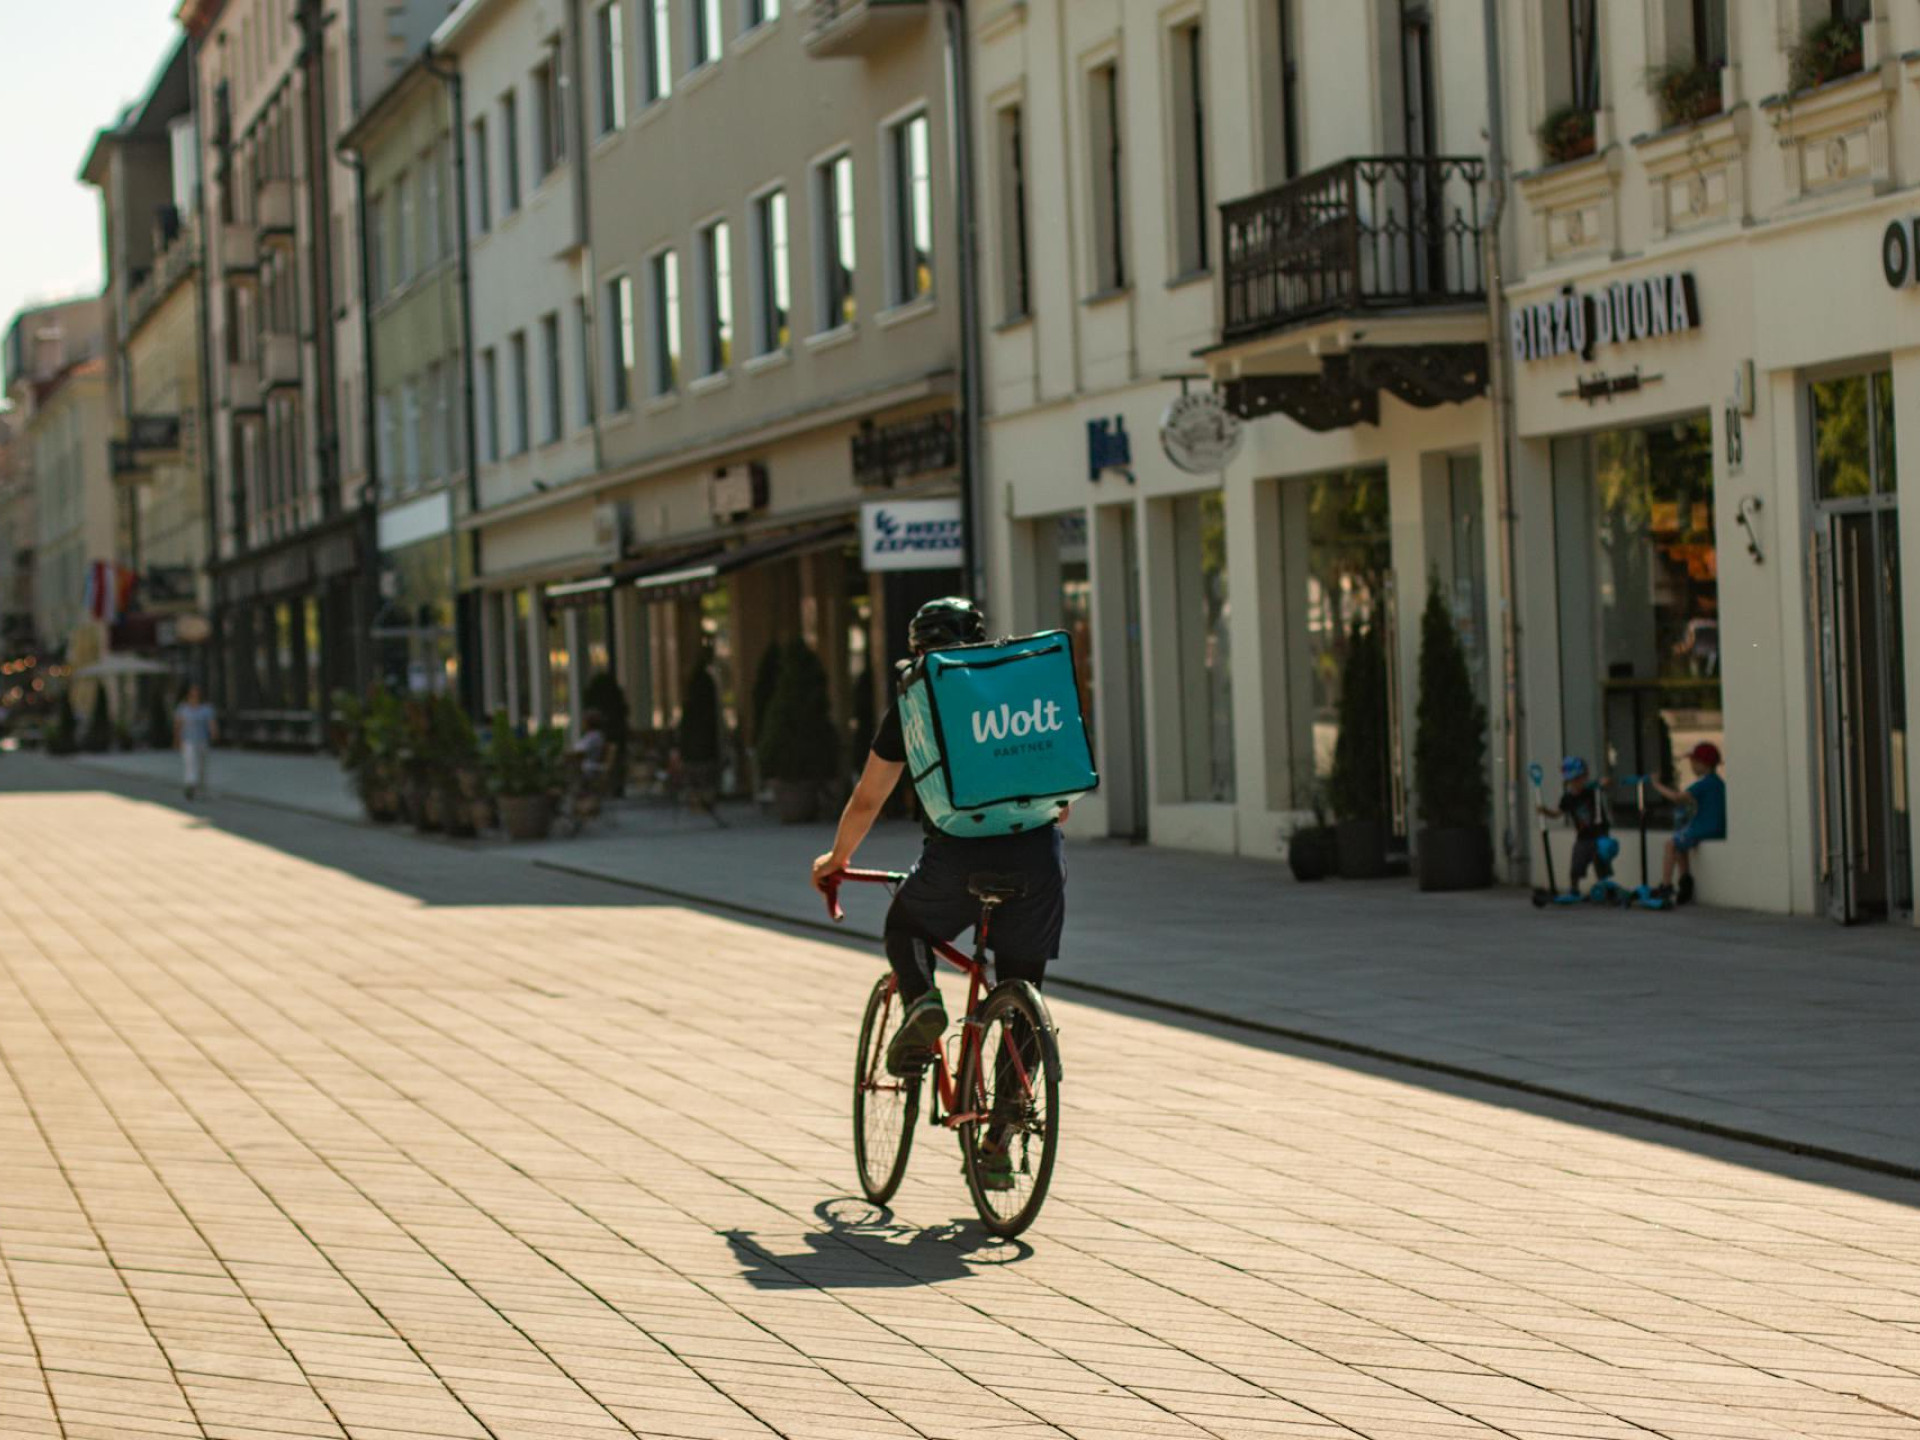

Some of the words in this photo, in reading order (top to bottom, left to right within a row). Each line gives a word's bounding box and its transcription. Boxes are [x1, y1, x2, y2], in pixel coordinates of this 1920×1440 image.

[1595, 272, 1699, 344] DUONA
[972, 698, 1063, 743] Wolt
[993, 740, 1053, 757] PARTNER
